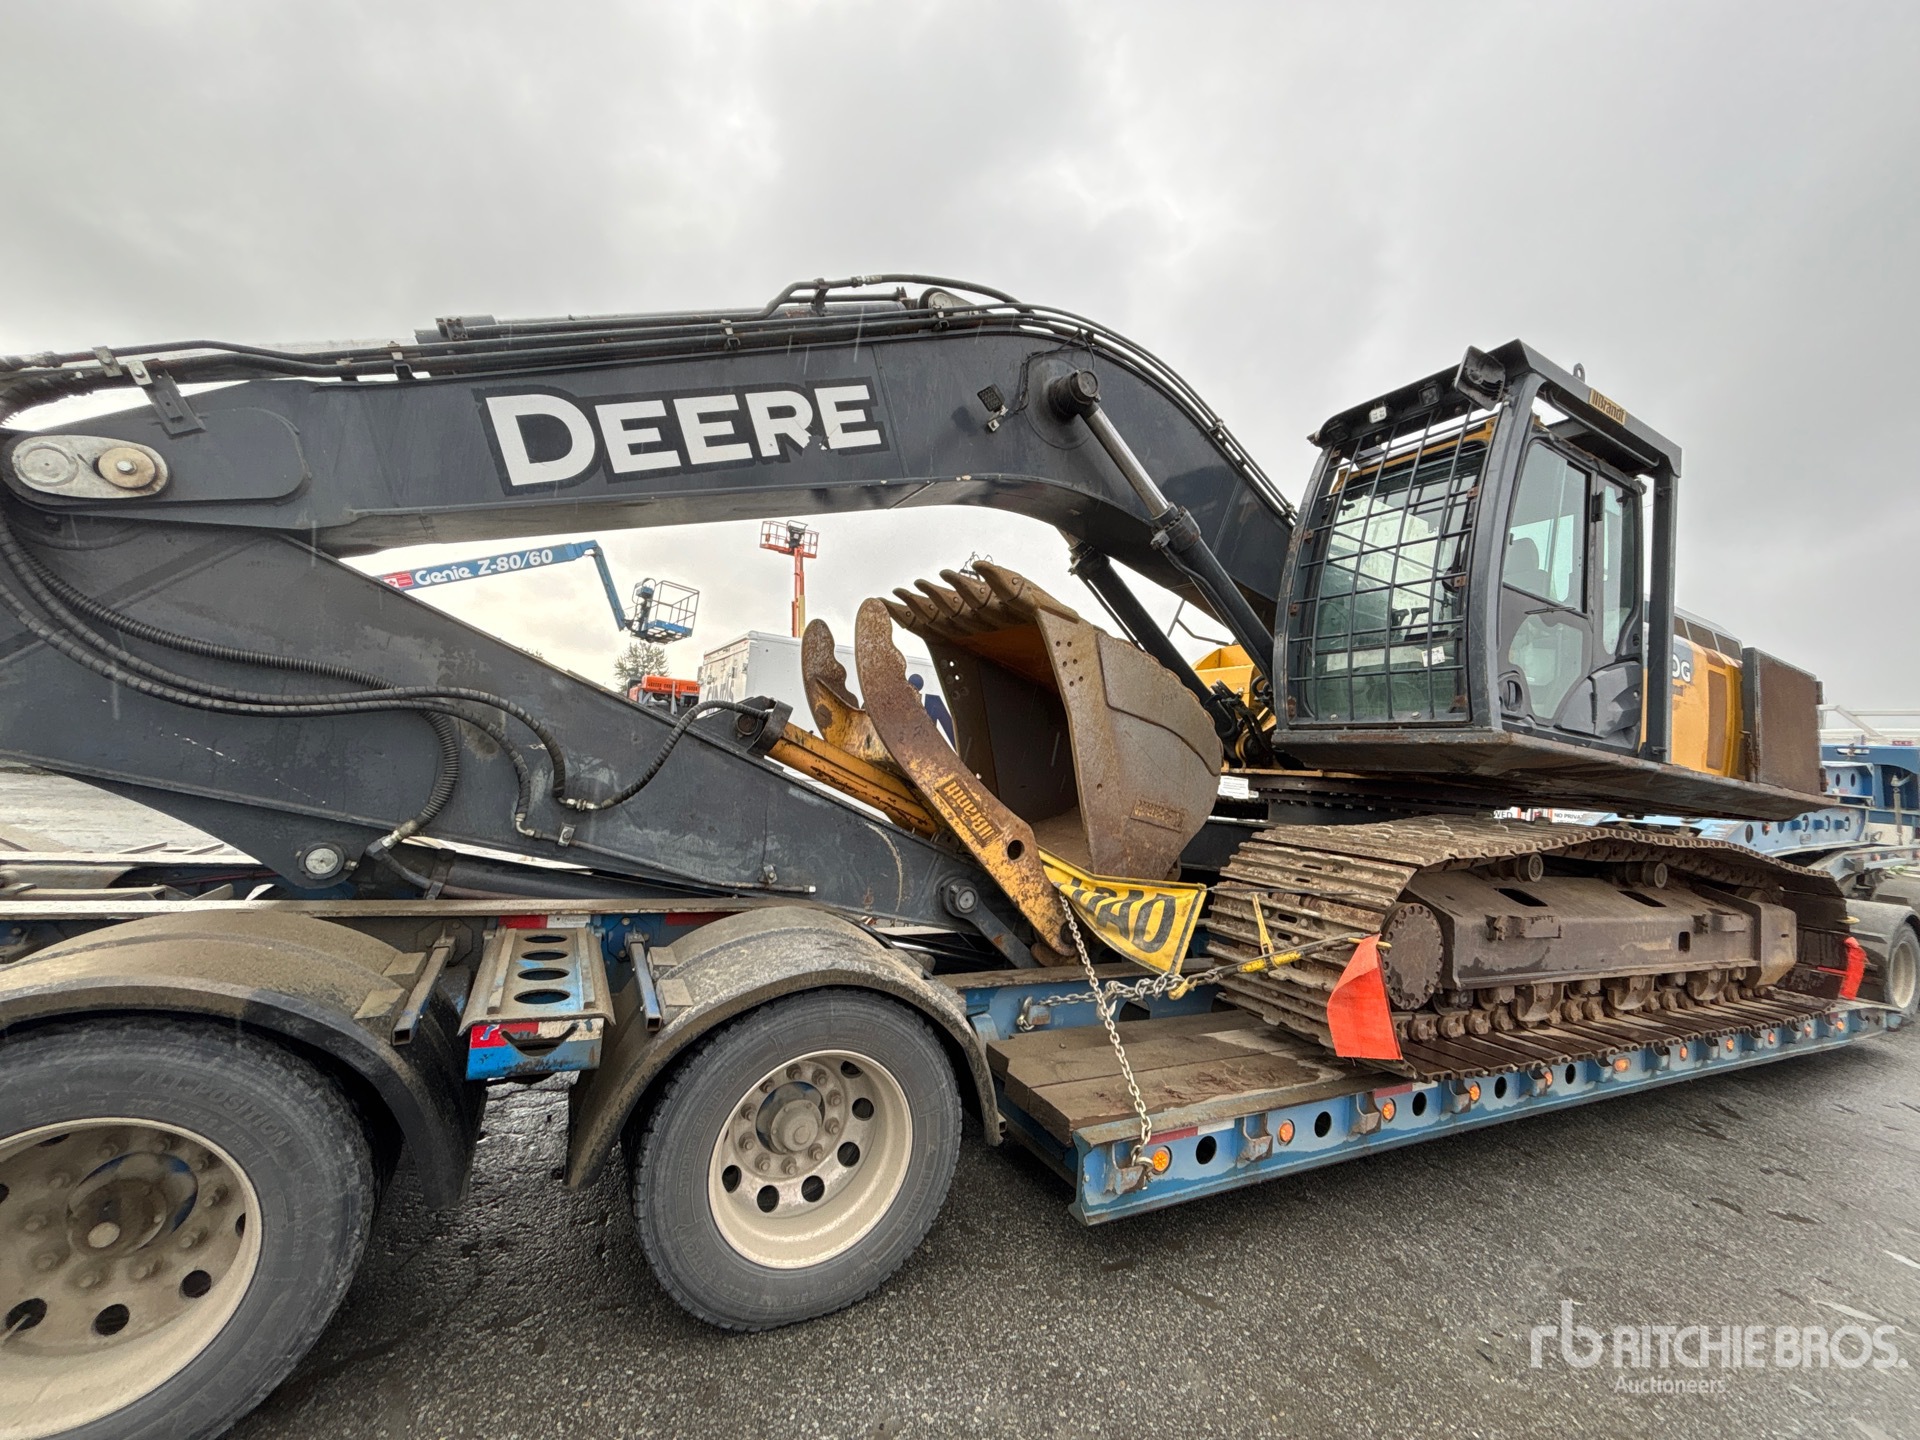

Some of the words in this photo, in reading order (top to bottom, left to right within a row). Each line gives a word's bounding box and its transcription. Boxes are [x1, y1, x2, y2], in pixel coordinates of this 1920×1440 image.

[485, 384, 882, 486] DEERE
[415, 565, 474, 586] Genie
[477, 549, 553, 576] Z-80/60
